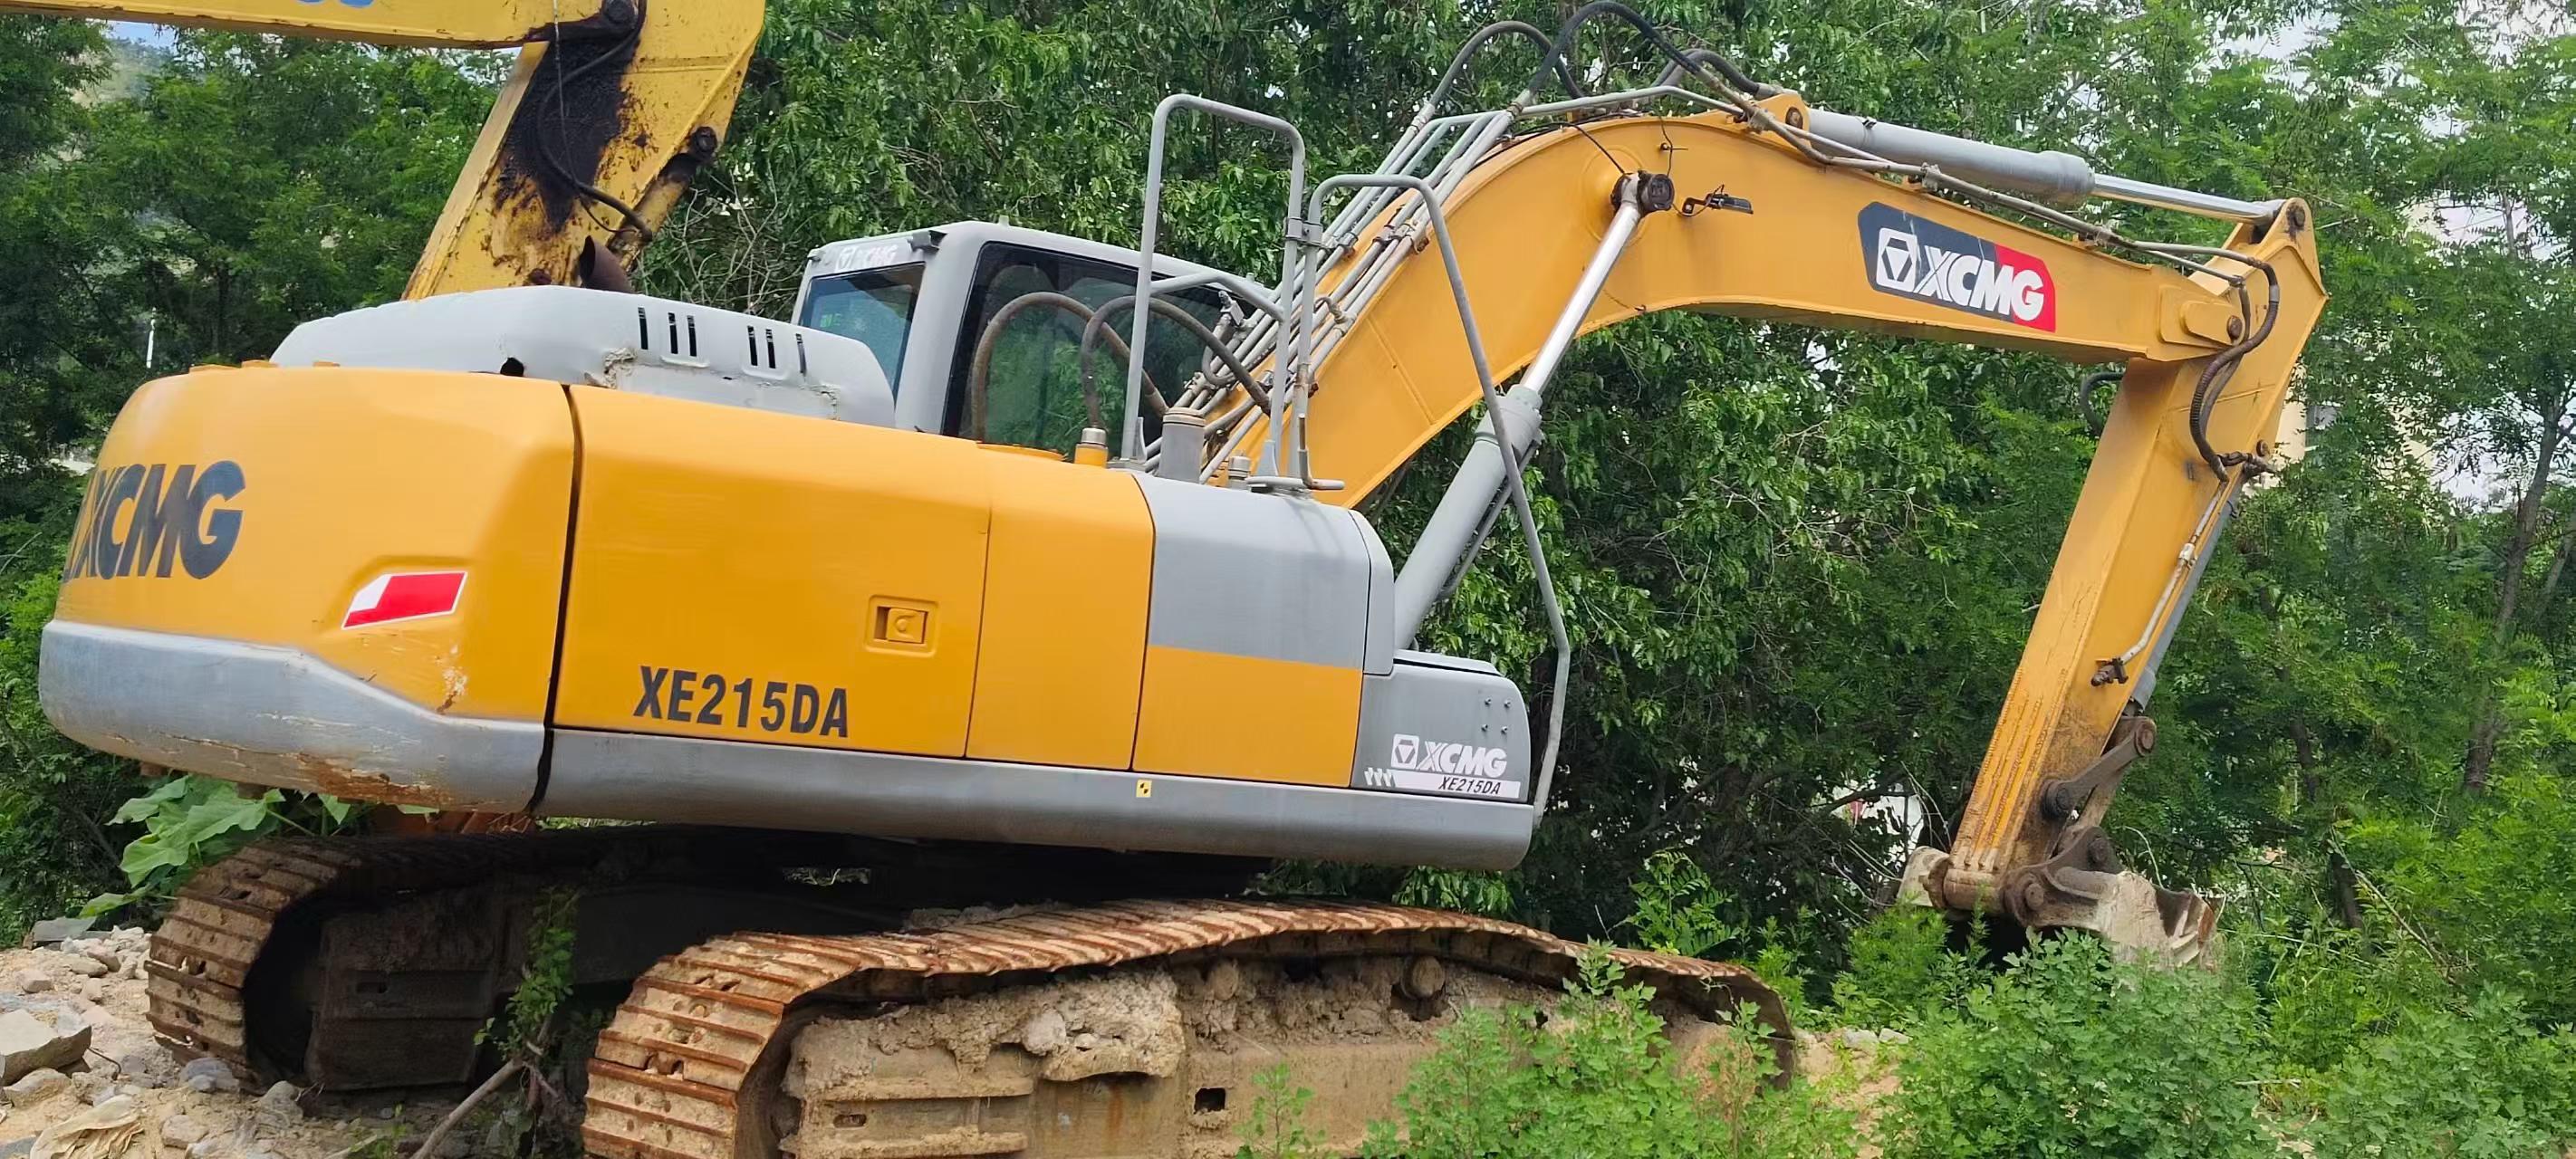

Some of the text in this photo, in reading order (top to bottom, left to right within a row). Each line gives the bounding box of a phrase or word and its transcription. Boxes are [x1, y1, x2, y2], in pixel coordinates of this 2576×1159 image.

[1913, 245, 2044, 321] XCMG
[68, 460, 246, 580] XCMG
[633, 665, 850, 738] XE215DA
[1416, 741, 1507, 778] XCMG
[1438, 776, 1501, 795] XE215DA
